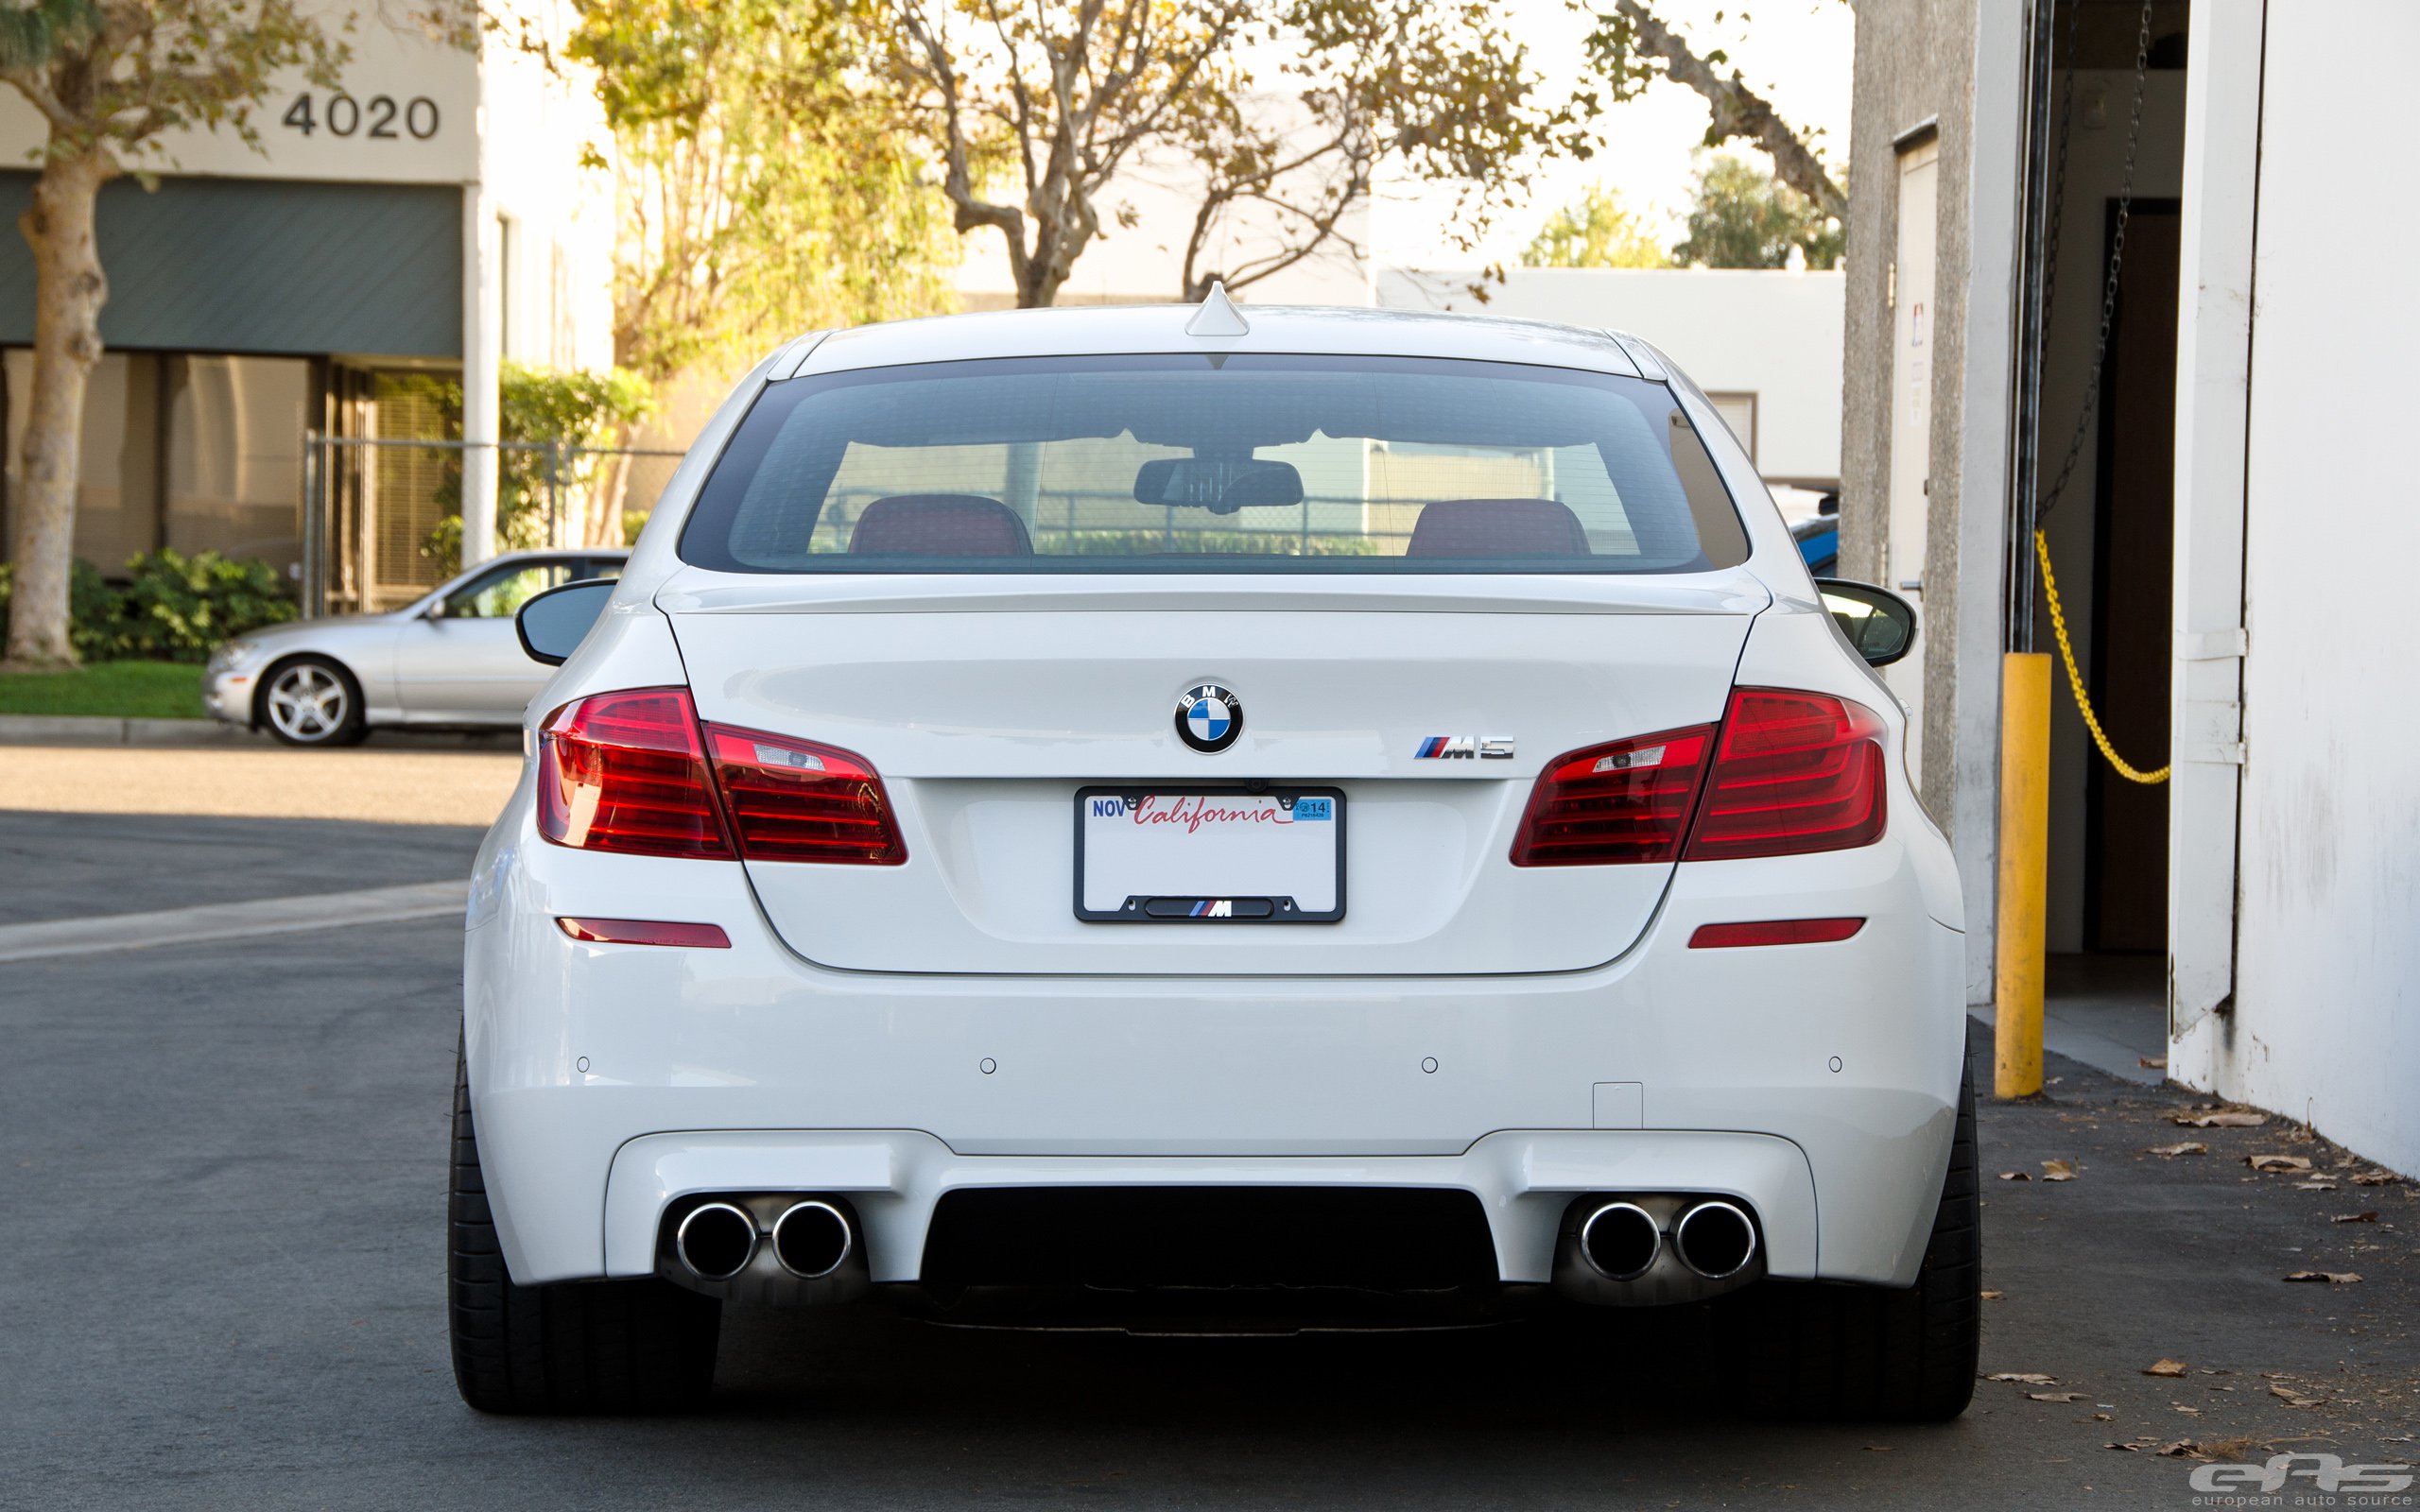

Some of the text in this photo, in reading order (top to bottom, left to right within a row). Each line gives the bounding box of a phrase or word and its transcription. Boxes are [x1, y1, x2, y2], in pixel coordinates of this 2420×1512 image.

[282, 92, 441, 141] 4020
[1181, 686, 1239, 708] BMW
[1438, 735, 1514, 760] M5
[1093, 799, 1126, 817] NOV
[1133, 795, 1294, 834] California
[1311, 802, 1325, 813] 14
